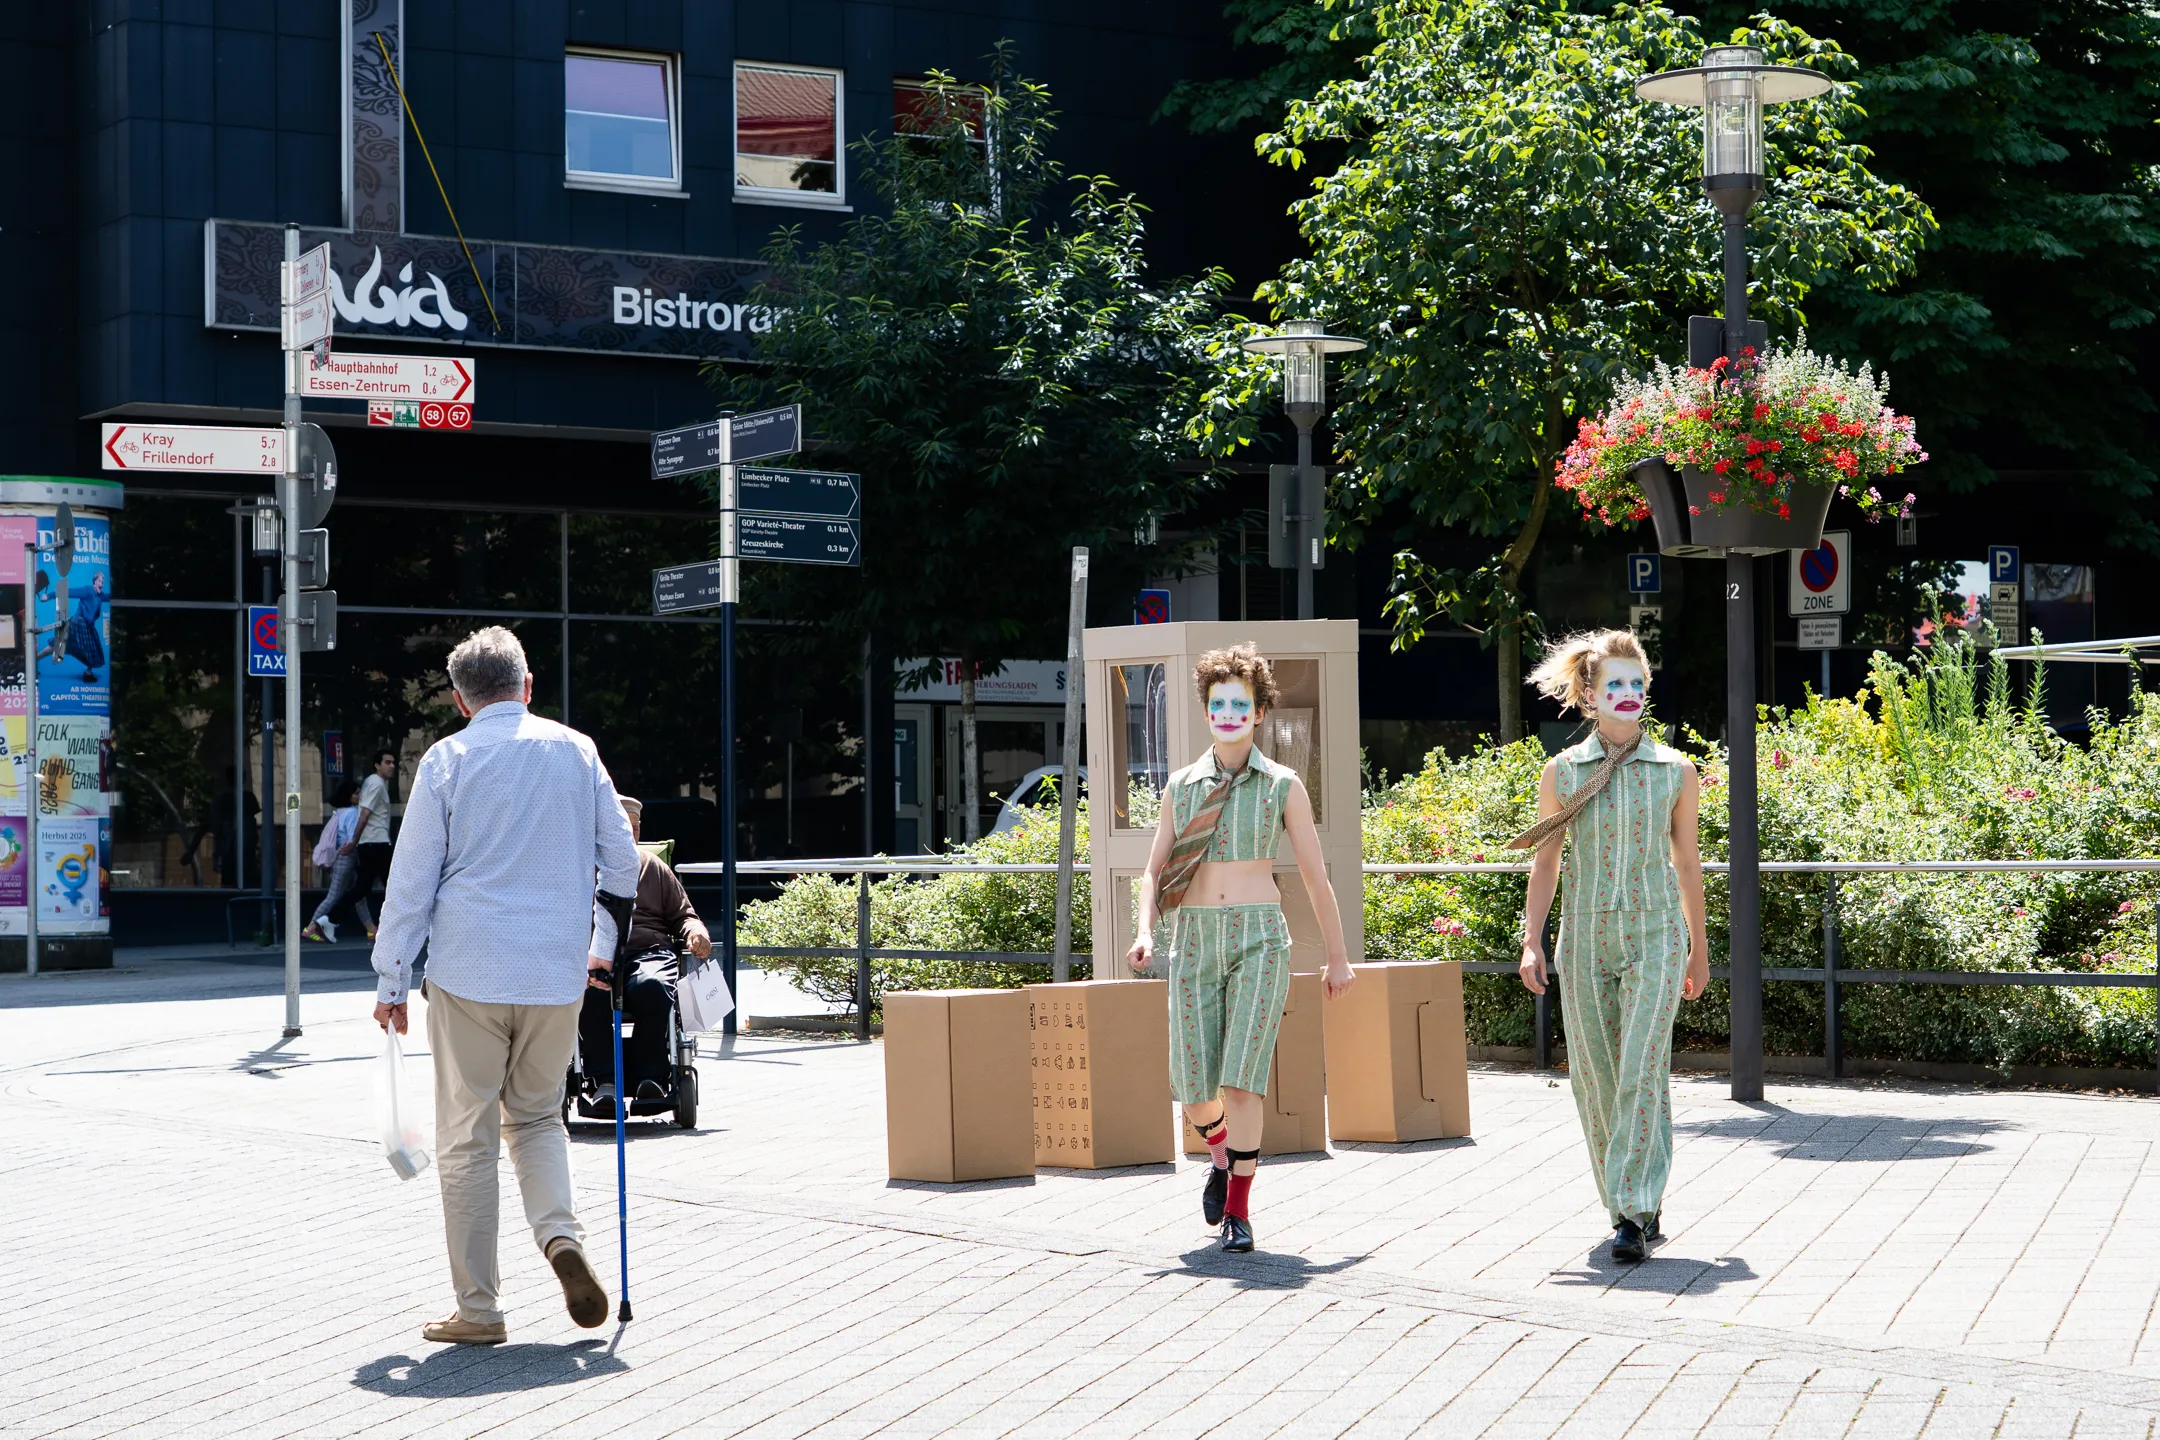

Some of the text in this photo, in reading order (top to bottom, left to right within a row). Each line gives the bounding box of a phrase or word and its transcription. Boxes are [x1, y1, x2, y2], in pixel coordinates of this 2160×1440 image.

[327, 360, 437, 377] Hauptbahnhof 1.2
[310, 377, 437, 395] Essen-Zentrum 0.6
[426, 410, 439, 420] 58
[452, 411, 465, 421] 57
[142, 433, 276, 449] Kray 5.7
[142, 451, 276, 467] Frillendorf 2.8
[741, 472, 849, 487] Limbecker Platz 0,7 km
[741, 519, 756, 527] GOP
[756, 520, 806, 530] Varieté-Theater
[827, 525, 837, 533] 0,1
[741, 539, 784, 549] Kreuzeskirche
[827, 544, 838, 552] 0,3
[1996, 551, 2011, 577] P
[1636, 559, 1652, 587] P
[1804, 595, 1834, 610] ZONE
[254, 654, 286, 670] TAX
[37, 723, 70, 741] FOLK
[67, 738, 99, 755] WANG
[71, 773, 100, 790] GANG
[39, 782, 58, 816] 2025
[41, 832, 88, 840] Herbst 2025
